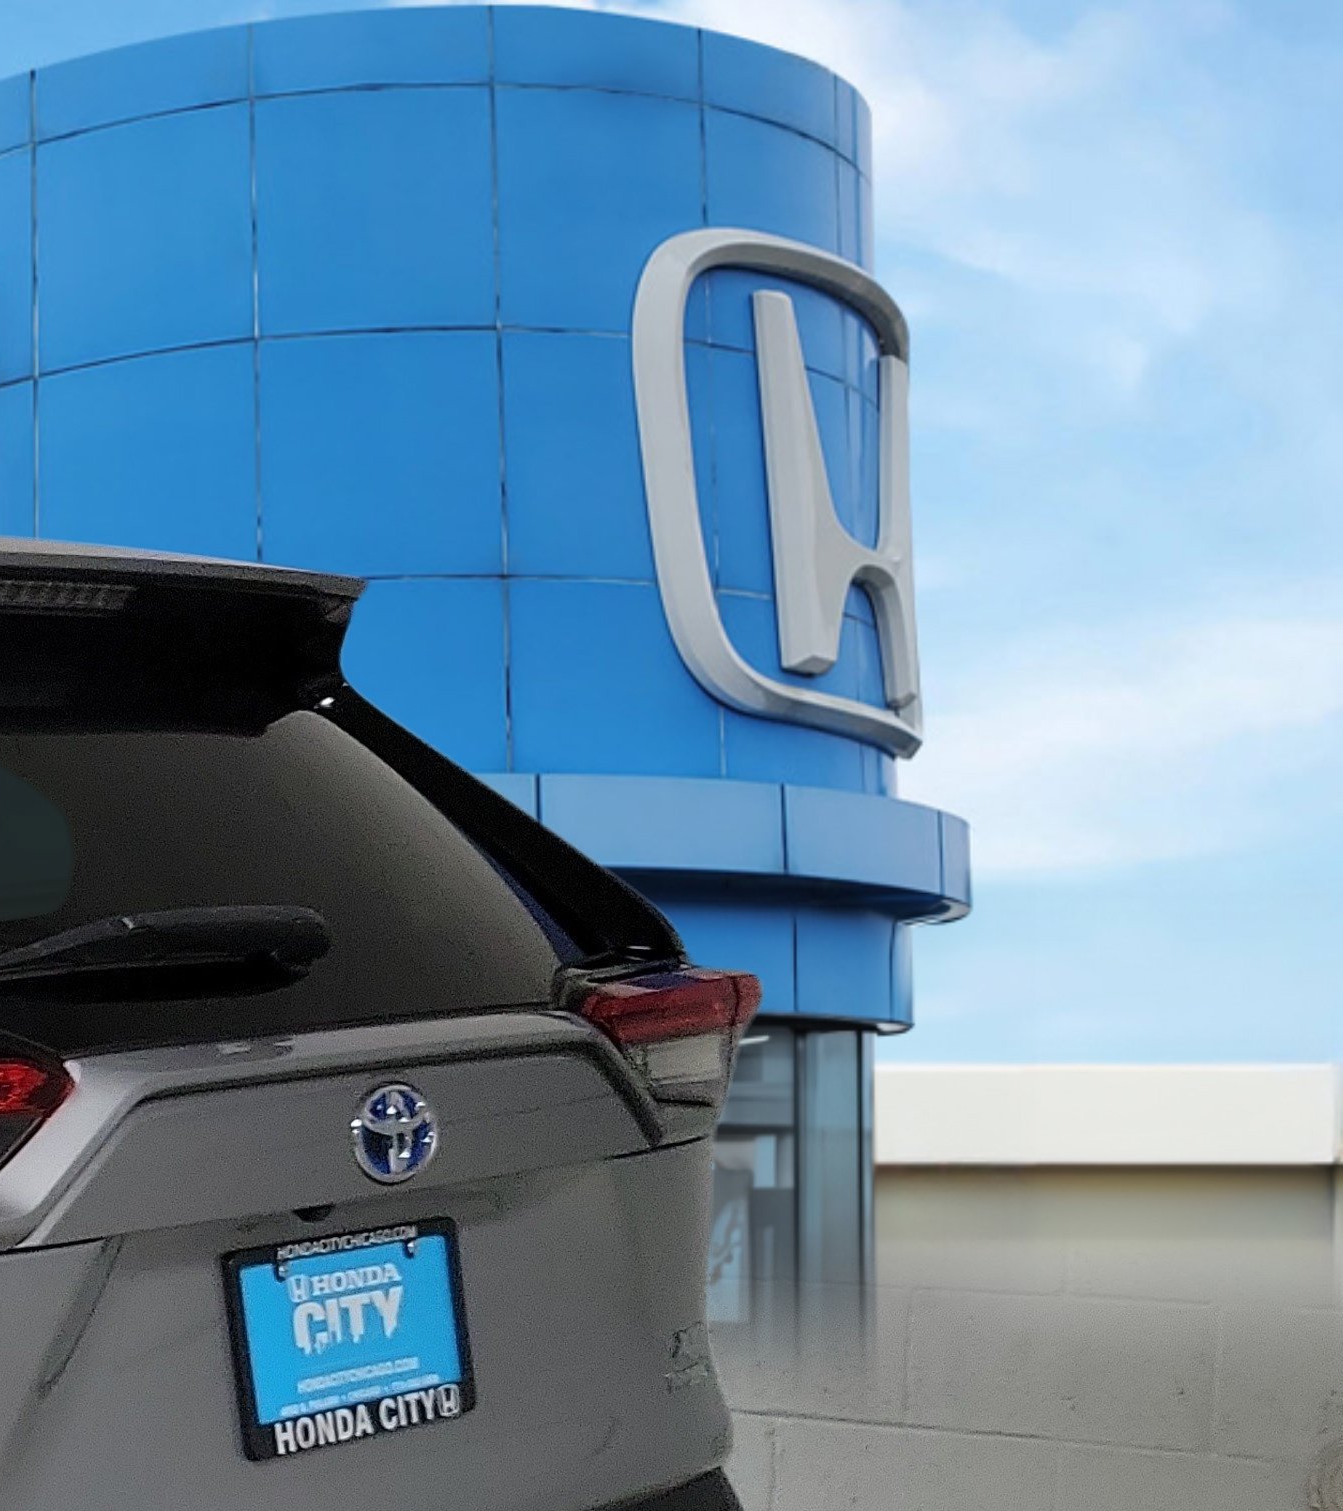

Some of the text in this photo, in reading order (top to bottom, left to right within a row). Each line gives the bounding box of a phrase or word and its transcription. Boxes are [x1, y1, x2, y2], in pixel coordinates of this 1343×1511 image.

[312, 1263, 401, 1296] HONDA
[292, 1285, 405, 1356] CITY
[274, 1403, 375, 1455] HONDA
[378, 1387, 437, 1431] CITY
